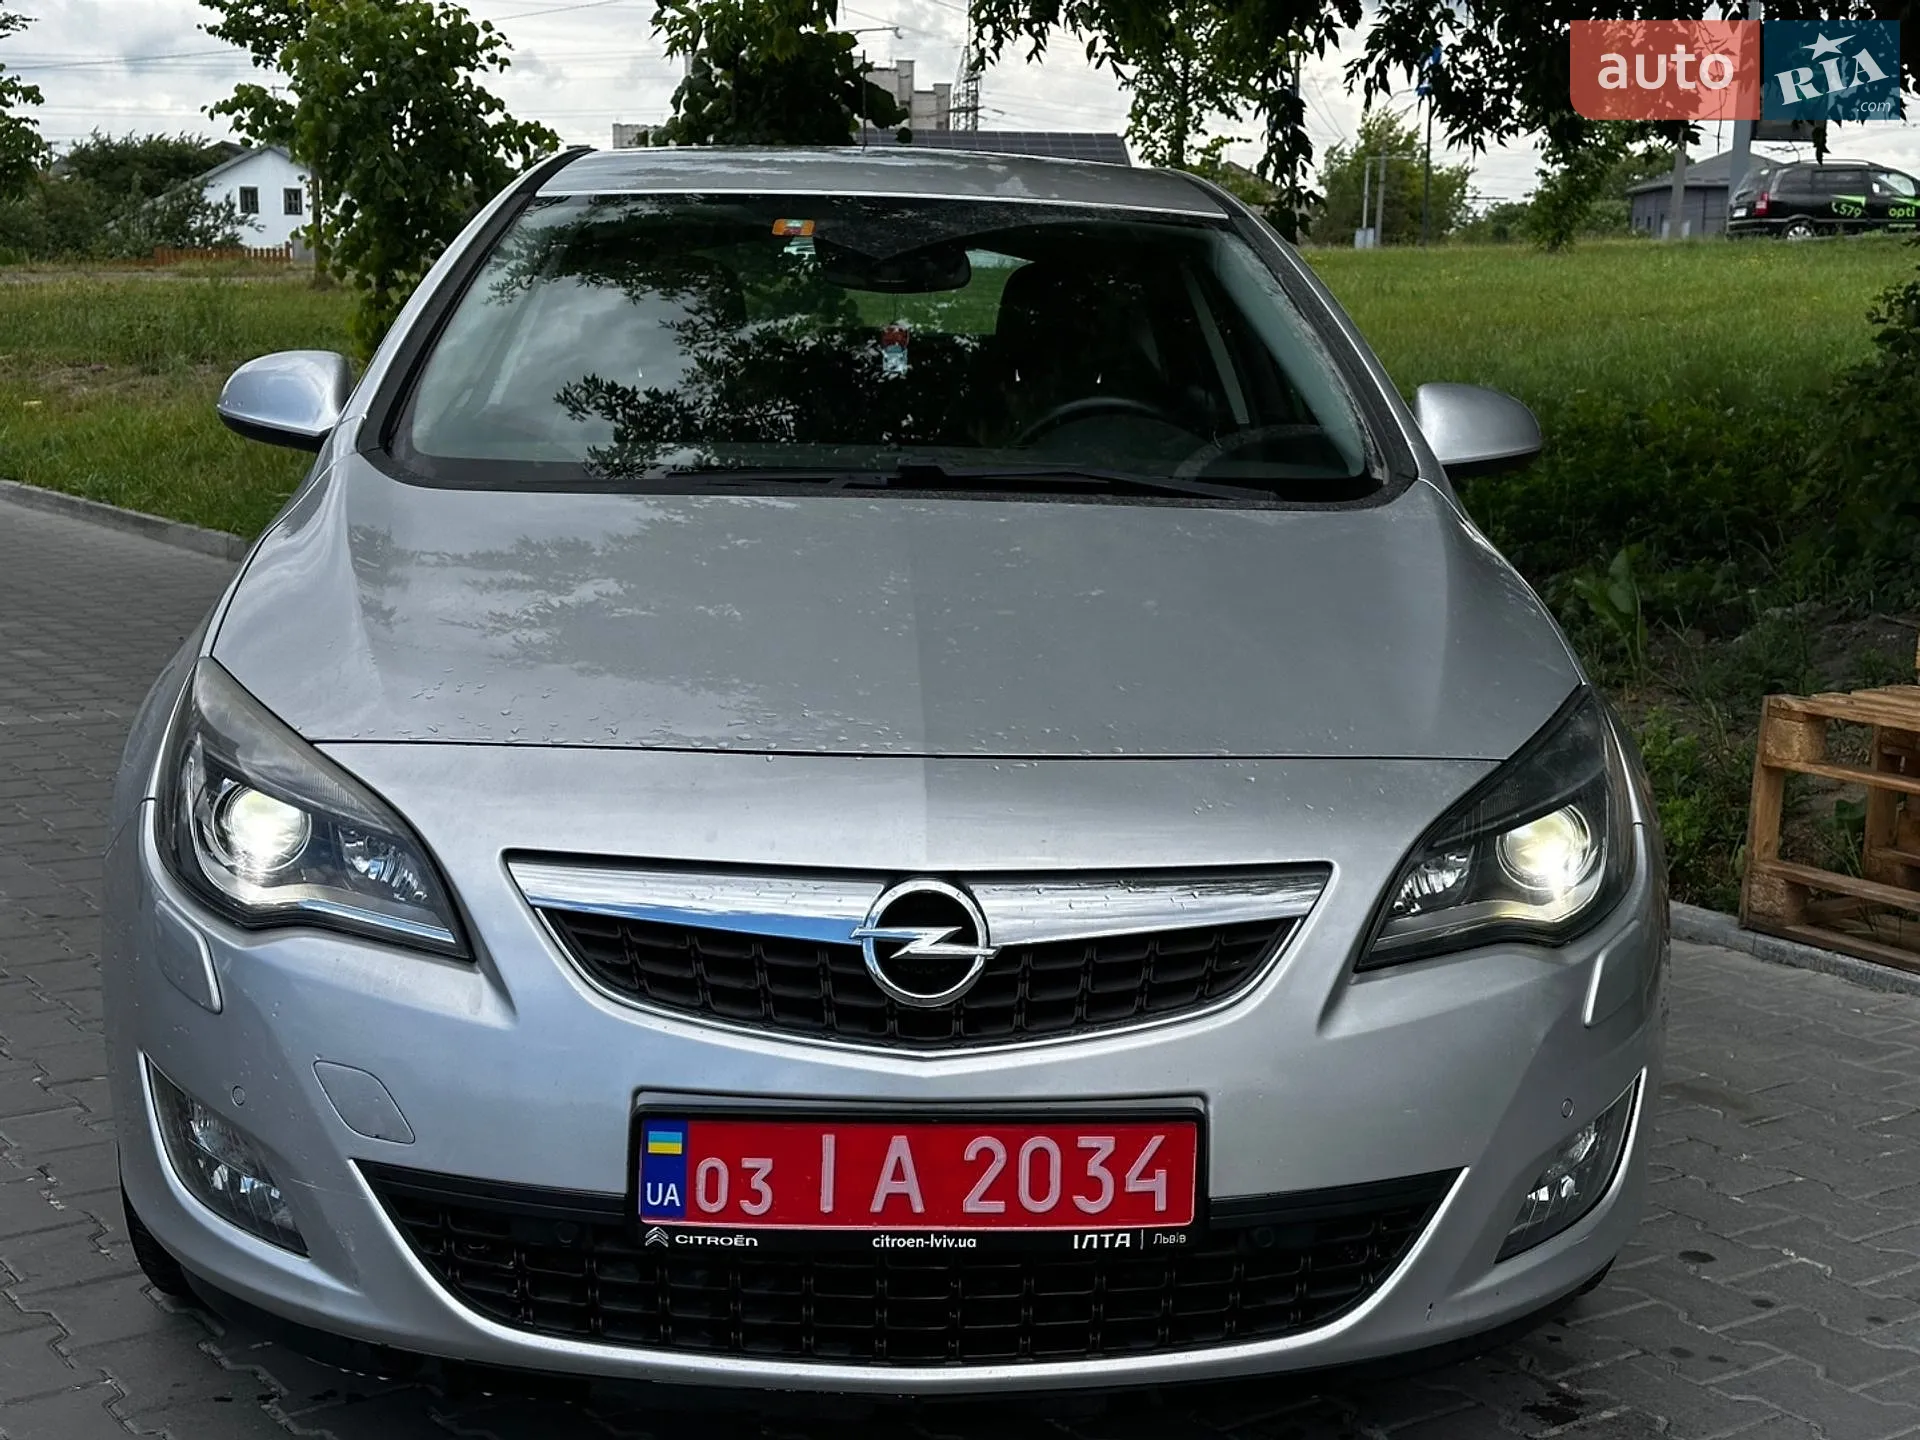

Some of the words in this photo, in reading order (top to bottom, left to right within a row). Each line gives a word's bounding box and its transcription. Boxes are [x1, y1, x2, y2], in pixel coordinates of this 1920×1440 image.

[1839, 203, 1862, 219] 579
[695, 1157, 774, 1216] 03
[962, 1135, 1168, 1215] 2034
[646, 1182, 681, 1207] UA
[872, 1232, 977, 1249] citroen-lviv.ua
